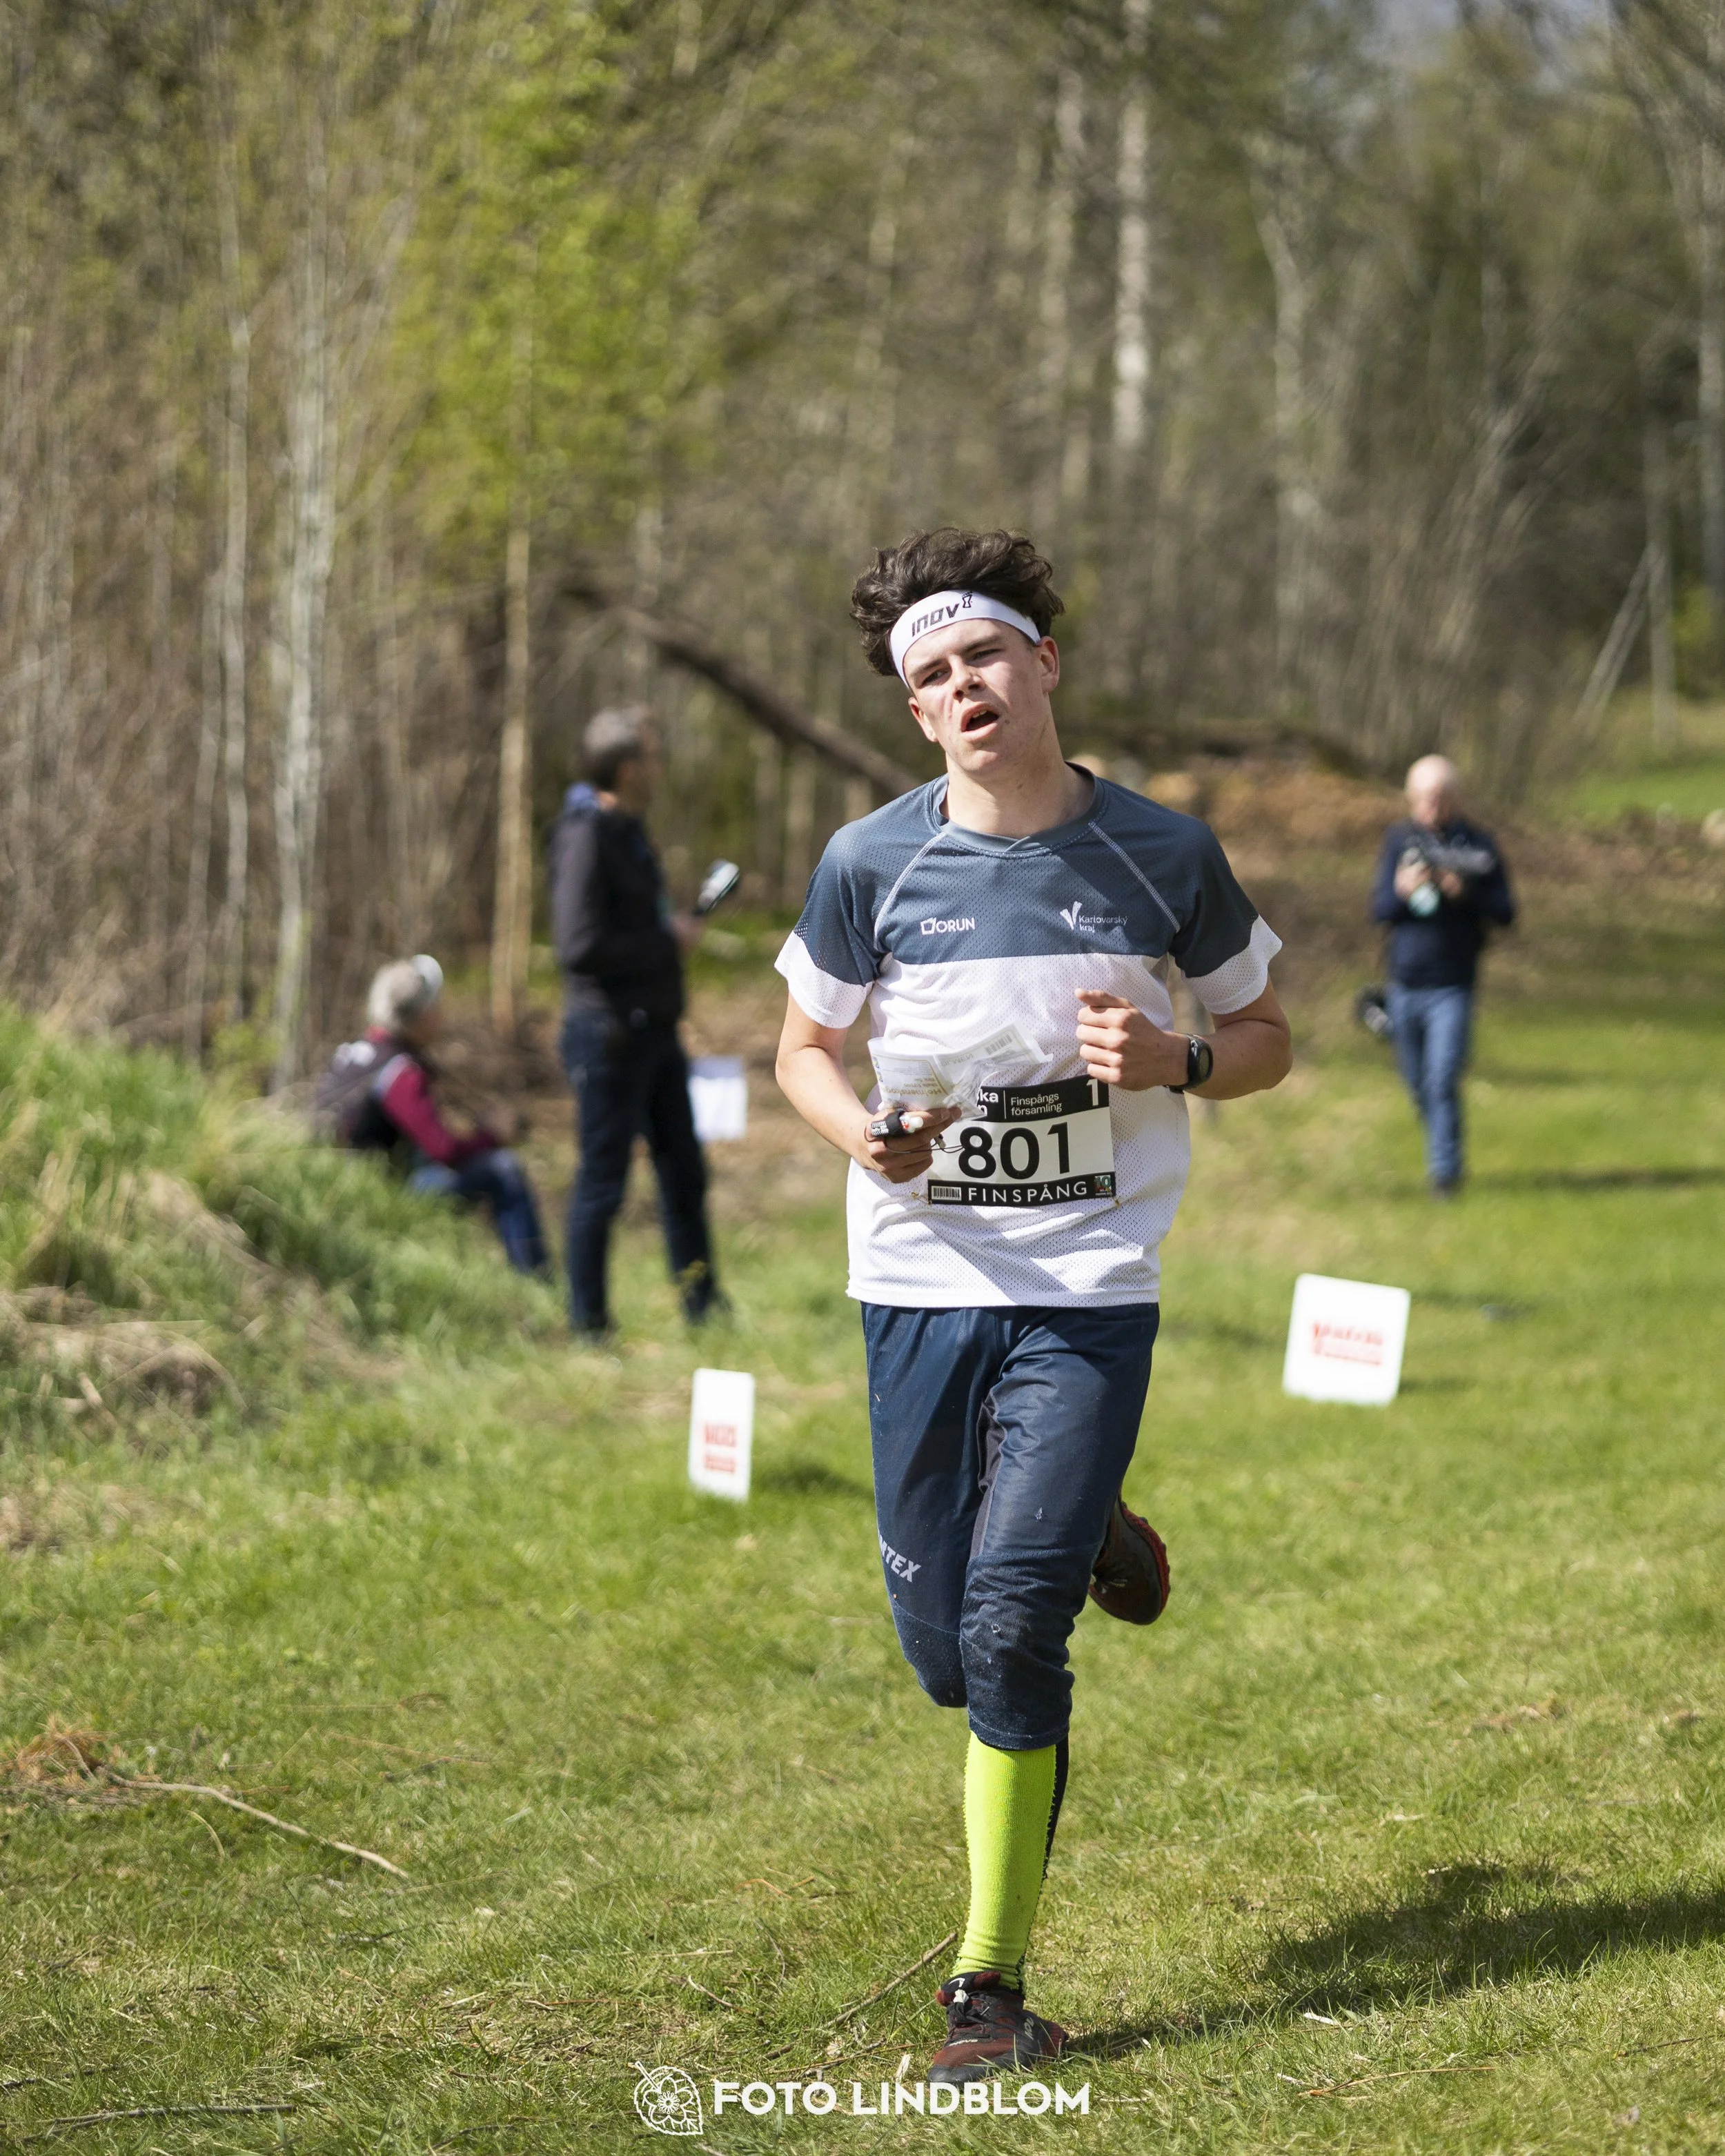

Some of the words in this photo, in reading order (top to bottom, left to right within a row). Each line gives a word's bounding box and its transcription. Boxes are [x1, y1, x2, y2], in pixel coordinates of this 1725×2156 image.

[1078, 915, 1127, 926] Karlovarský
[1079, 924, 1095, 933] kraj
[1086, 1078, 1099, 1106] 1
[1011, 1093, 1059, 1107] Finspångs
[1011, 1102, 1063, 1116] församling
[958, 1122, 1070, 1179] 801
[968, 1180, 1087, 1203] FINSPÅNG
